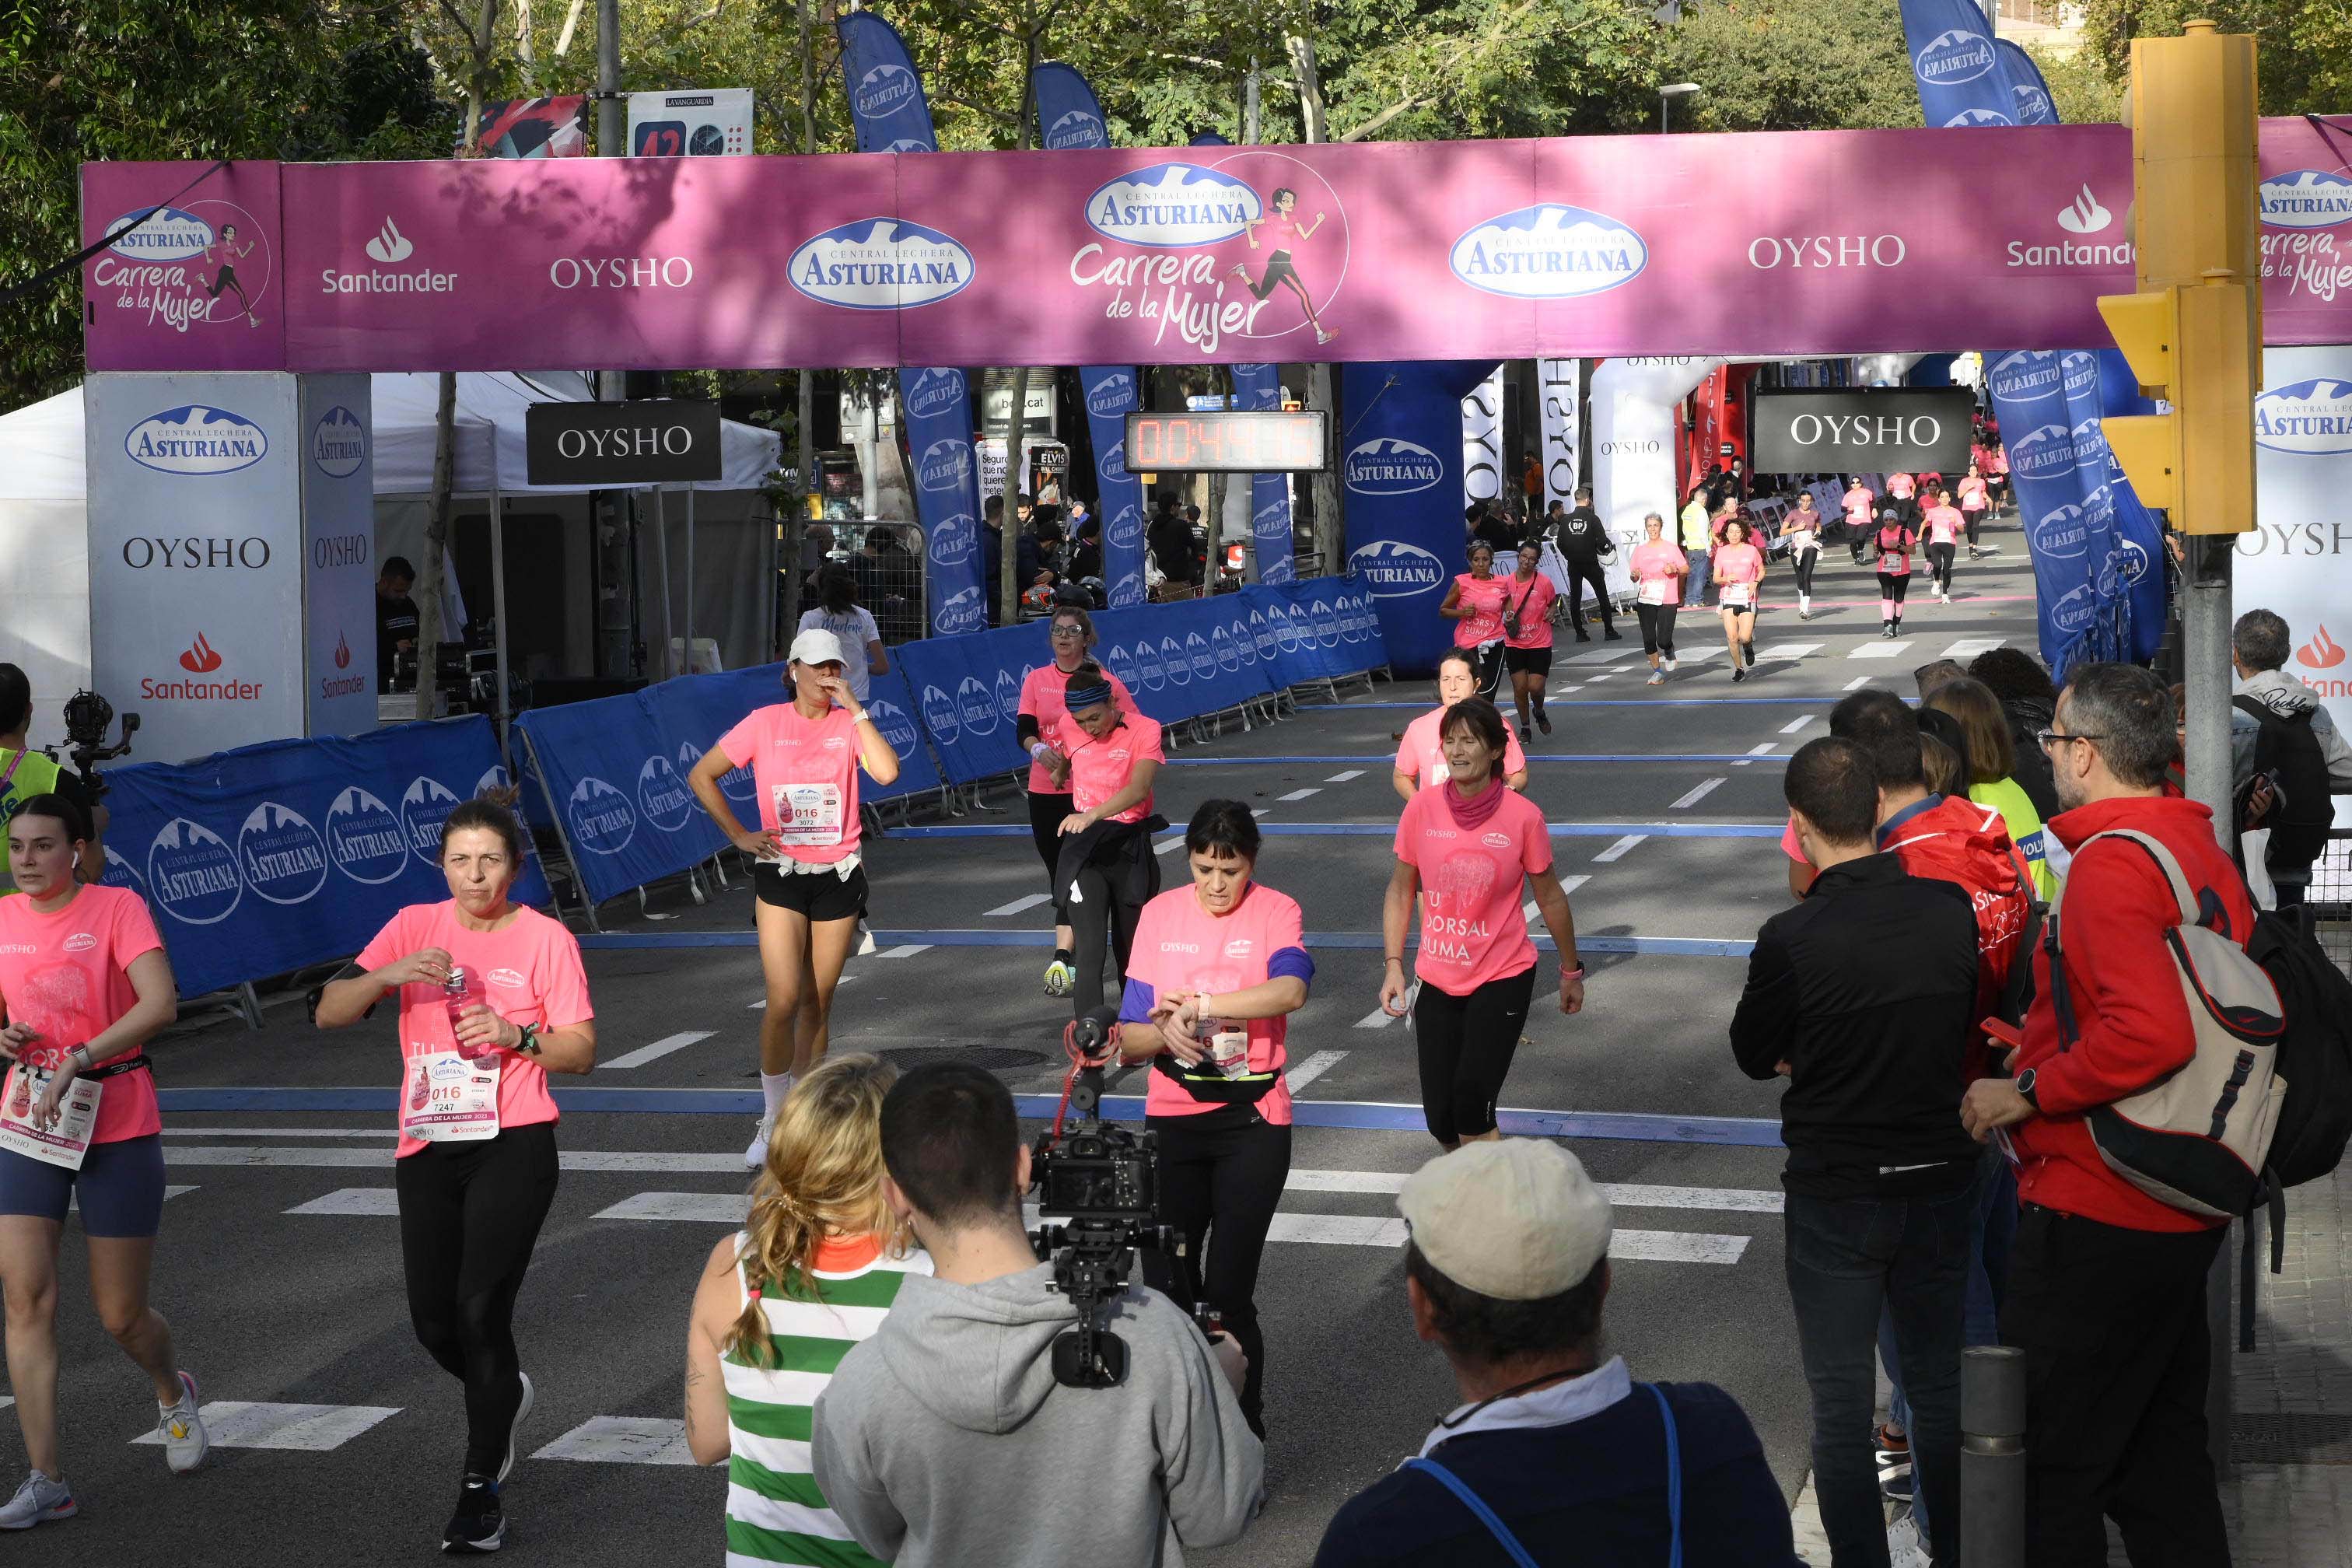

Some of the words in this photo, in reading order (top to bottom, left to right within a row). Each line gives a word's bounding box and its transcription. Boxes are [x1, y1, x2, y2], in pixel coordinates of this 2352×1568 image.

[1125, 192, 1181, 201] CENTRAL
[1098, 194, 1248, 226] ASTURIANA
[831, 250, 889, 258] CENTRAL
[895, 249, 954, 257] LECHERA
[1465, 240, 1632, 275] ASTURIANA
[1748, 234, 1906, 269] OYSHO
[2007, 240, 2137, 267] Santand
[94, 257, 186, 286] Carrera
[550, 257, 693, 289] OYSHO
[802, 253, 960, 285] ASTURIANA
[1070, 243, 1216, 286] Carrera
[2279, 257, 2292, 277] la
[322, 269, 458, 293] Santander
[117, 289, 134, 308] de
[138, 289, 149, 308] la
[148, 285, 220, 332] Mujer
[1106, 289, 1132, 318] de
[1139, 288, 1158, 318] la
[1154, 280, 1269, 353] Mujer
[558, 426, 692, 458] OYSHO
[1790, 414, 1941, 446] OYSHO
[136, 431, 258, 457] ASTURIANA
[317, 434, 362, 460] ASTURIANA
[1601, 440, 1659, 456] OYSHO
[1041, 453, 1064, 463] ELVIS
[1348, 461, 1436, 482] ASTURIANA
[123, 537, 270, 569] OYSHO
[315, 534, 367, 569] OYSHO
[1465, 626, 1489, 636] SUMA
[141, 678, 263, 701] Santander
[322, 674, 365, 699] Santander
[1039, 725, 1054, 734] TU
[795, 808, 817, 817] 016
[341, 821, 368, 832] CENTRAL
[1426, 828, 1457, 839] OYSHO
[334, 826, 404, 863] ASTURIANA
[247, 844, 324, 884] ASTURIANA
[158, 862, 238, 903] ASTURIANA
[1428, 890, 1440, 908] TU
[1161, 943, 1199, 954] OYSHO
[1423, 937, 1470, 960] SUMA
[432, 1087, 460, 1100] 016
[9, 1124, 30, 1135] CARRERA
[2, 1135, 29, 1149] OYSHO
[49, 1150, 75, 1160] Santander
